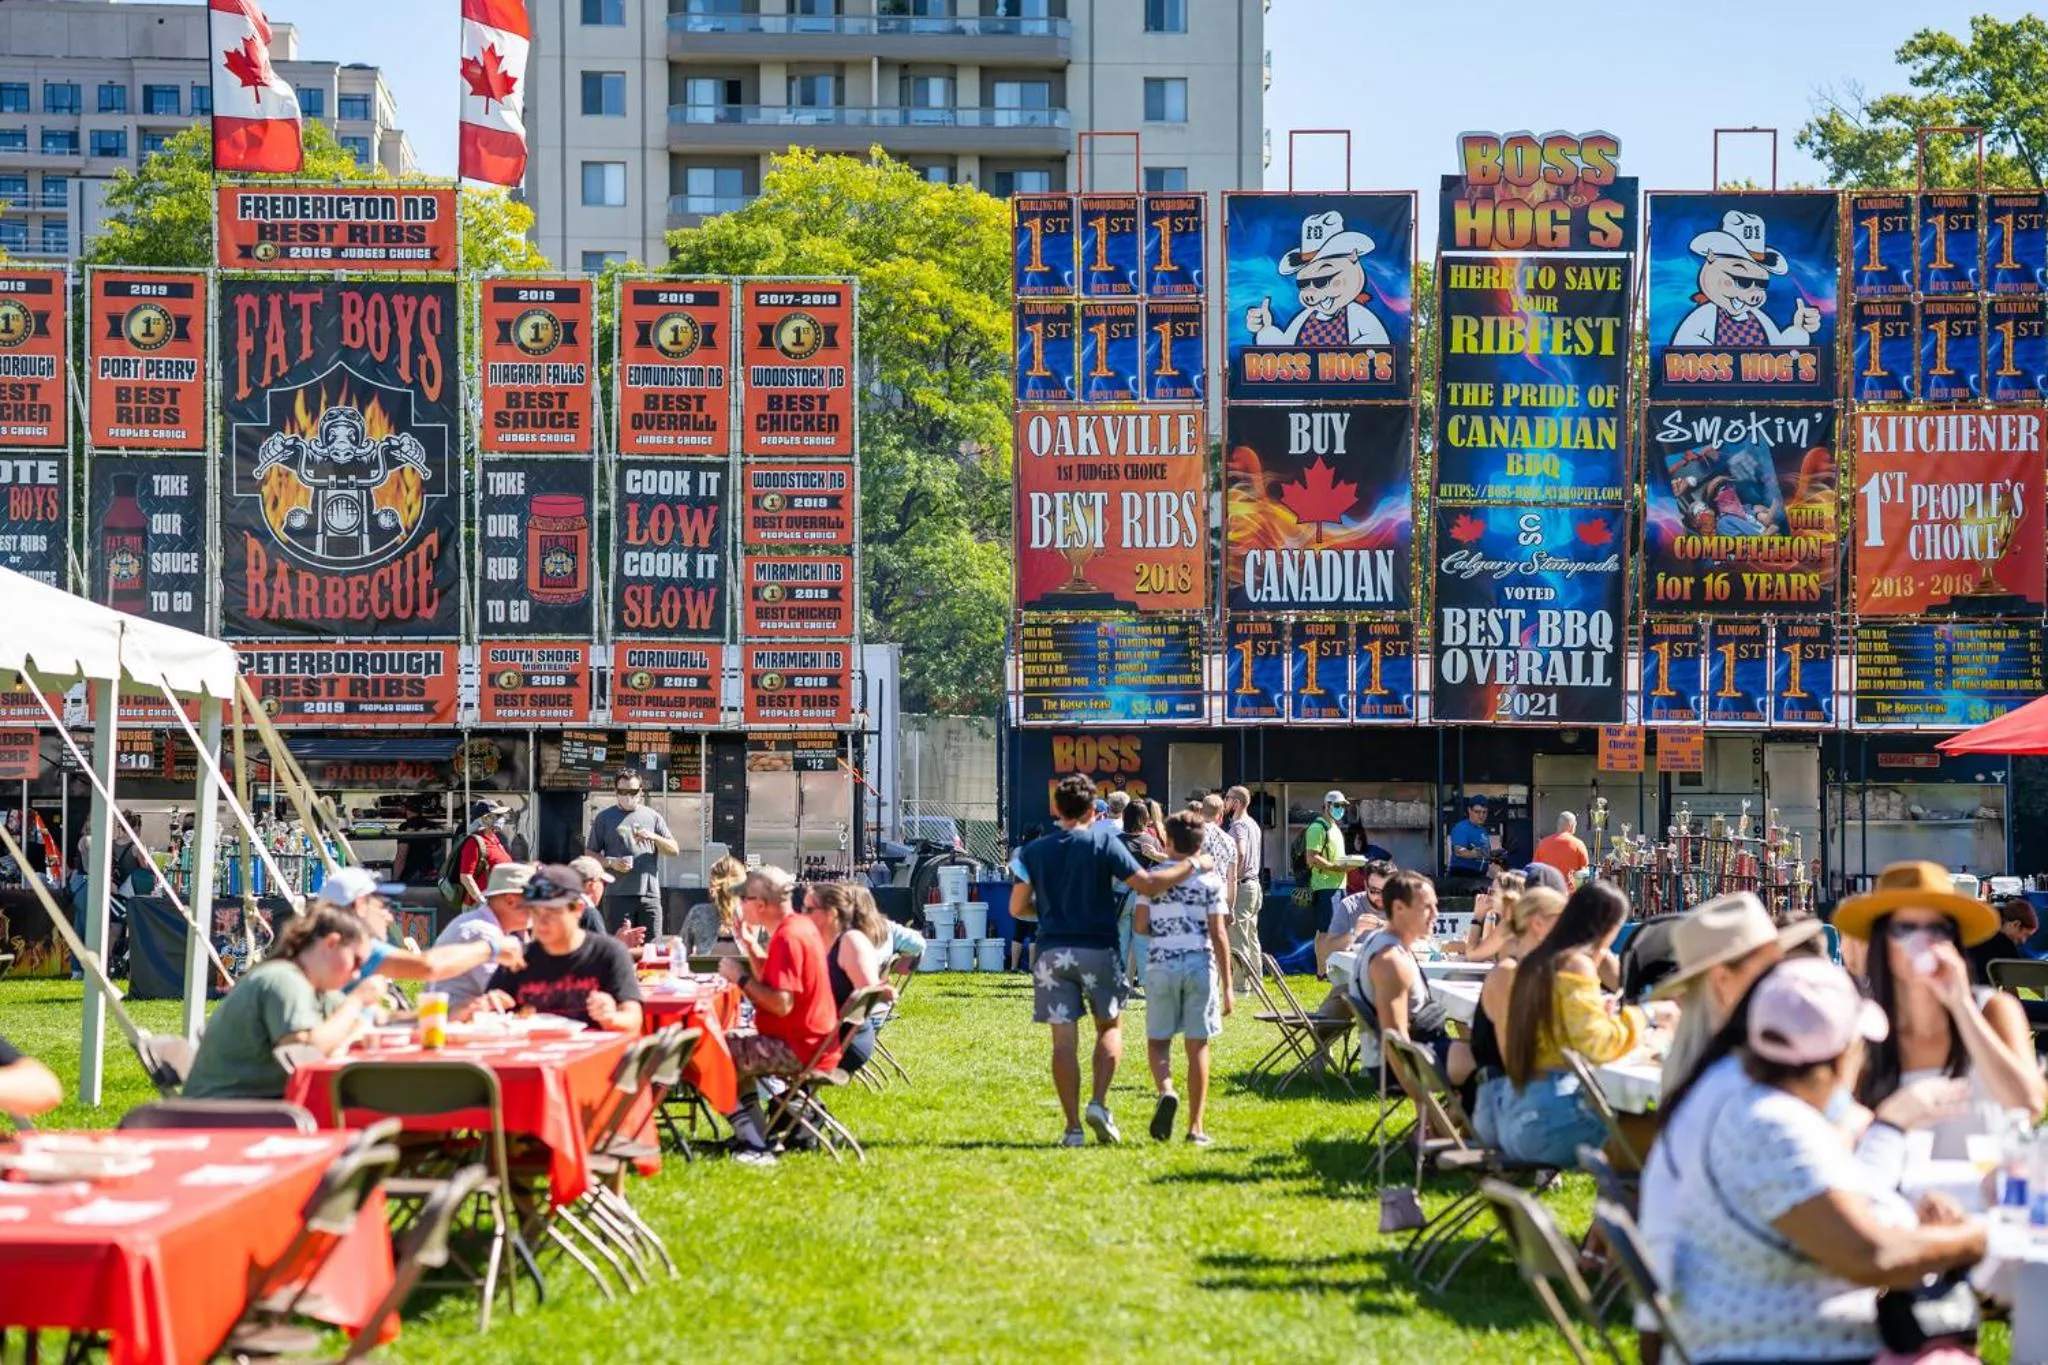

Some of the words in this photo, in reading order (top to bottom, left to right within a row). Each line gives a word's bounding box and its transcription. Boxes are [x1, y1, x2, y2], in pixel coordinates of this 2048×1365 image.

[1460, 133, 1620, 187] BOSS
[237, 194, 398, 222] FREDERICTON
[402, 195, 438, 222] NB
[257, 223, 338, 243] BEST
[348, 224, 426, 245] RIBS
[1023, 216, 1070, 272] 1ST
[1088, 216, 1135, 272] 1ST
[1152, 216, 1198, 272] 1ST
[1860, 215, 1908, 271] 1ST
[1927, 213, 1975, 269] 1ST
[1994, 213, 2043, 269] 1ST
[290, 247, 332, 259] 2019
[340, 247, 385, 259] JUDGES
[389, 248, 431, 259] CHOICE
[130, 284, 168, 296] 2019
[1450, 264, 1514, 289] HERE
[1525, 265, 1556, 290] TO
[1565, 266, 1622, 291] SAVE
[518, 290, 556, 301] 2019
[658, 293, 695, 304] 2019
[759, 294, 837, 305] 2017-2019
[1511, 296, 1559, 313] YOUR
[233, 288, 324, 400] FAT
[339, 291, 443, 402] BOYS
[1450, 315, 1621, 356] RIBFEST
[99, 356, 141, 380] PORT
[143, 357, 197, 381] PERRY
[489, 363, 543, 388] NIAGARA
[545, 364, 586, 386] FALLS
[627, 364, 705, 389] EDMUNDSTON
[707, 366, 724, 390] NB
[751, 365, 827, 389] WOODSTOCK
[828, 365, 845, 391] NB
[1245, 353, 1311, 381] BOSS
[1319, 350, 1392, 381] HOG'S
[1666, 353, 1734, 381] BOSS
[1741, 350, 1816, 381] HOG'S
[115, 385, 181, 404] BEST
[505, 391, 569, 410] BEST
[644, 394, 707, 412] BEST
[767, 394, 829, 412] BEST
[1447, 382, 1494, 407] THE
[1502, 383, 1579, 408] PRIDE
[1587, 384, 1620, 408] OF
[115, 407, 181, 425] RIBS
[494, 411, 580, 430] SAUCE
[631, 414, 717, 432] OVERALL
[756, 413, 839, 433] CHICKEN
[109, 427, 150, 438] PEOPLES
[152, 429, 187, 439] CHOICE
[498, 433, 537, 443] JUDGES
[540, 434, 576, 443] CHOICE
[635, 435, 675, 445] JUDGES
[677, 436, 713, 446] CHOICE
[1028, 414, 1197, 456] OAKVILLE
[1289, 413, 1350, 454] BUY
[1447, 414, 1618, 450] CANADIAN
[1861, 414, 2040, 453] KITCHENER
[1076, 464, 1120, 482] JUDGES
[1124, 463, 1167, 480] CHOICE
[1506, 452, 1560, 479] BBQ
[152, 474, 188, 497] TAKE
[487, 472, 525, 497] TAKE
[626, 469, 691, 496] COOK
[699, 471, 721, 497] IT
[752, 471, 826, 489] WOODSTOCK
[828, 471, 845, 491] NB
[9, 486, 59, 521] BOYS
[794, 497, 828, 508] 2019
[1860, 471, 1907, 547] 1ST
[1911, 478, 2025, 521] PEOPLE'S
[152, 513, 182, 536] OUR
[487, 514, 519, 539] OUR
[625, 502, 719, 548] LOW
[753, 515, 783, 529] BEST
[786, 516, 844, 529] OVERALL
[1029, 492, 1108, 549] BEST
[1121, 491, 1197, 549] RIBS
[1790, 508, 1825, 530] THE
[20, 535, 47, 553] RIBS
[1673, 535, 1823, 562] COMPETITION
[1909, 523, 1999, 562] CHOICE
[152, 552, 199, 575] SAUCE
[243, 528, 441, 620] BARBECUE
[487, 557, 518, 581] RUB
[623, 551, 689, 578] COOK
[696, 554, 719, 579] IT
[754, 562, 825, 582] MIRAMICHI
[826, 562, 843, 582] NB
[1245, 549, 1394, 603] CANADIAN
[1441, 549, 1518, 580] Calgary
[1518, 551, 1620, 579] Stampede
[1135, 563, 1192, 594] 2018
[1656, 572, 1695, 601] for
[1703, 572, 1731, 601] 16
[1742, 572, 1821, 601] YEARS
[1871, 575, 1915, 597] 2013
[1930, 573, 1974, 596] 2018
[151, 591, 169, 612] TO
[173, 592, 192, 612] GO
[1504, 587, 1555, 600] VOTED
[487, 600, 505, 623] TO
[510, 600, 530, 623] GO
[623, 584, 717, 630] SLOW
[755, 607, 786, 620] BEST
[788, 607, 842, 621] CHICKEN
[1442, 608, 1525, 647] BEST
[1537, 609, 1614, 654] BBQ
[238, 650, 444, 677] PETERBOROUGH
[490, 648, 533, 664] SOUTH
[537, 649, 581, 664] SHORE
[627, 649, 709, 670] CORNWALL
[753, 651, 822, 669] MIRAMICHI
[824, 651, 843, 669] NB
[1234, 639, 1280, 695] 1ST
[1298, 639, 1345, 695] 1ST
[1363, 639, 1409, 695] 1ST
[1441, 648, 1612, 687] OVERALL
[532, 676, 566, 686] 2019
[1650, 641, 1697, 697] 1ST
[1716, 642, 1764, 697] 1ST
[1781, 642, 1829, 698] 1ST
[261, 678, 340, 698] BEST
[350, 678, 426, 699] RIBS
[664, 677, 697, 687] 2019
[303, 702, 345, 713] 2019
[494, 694, 527, 707] BEST
[529, 694, 572, 708] SAUCE
[617, 695, 643, 706] BEST
[645, 696, 686, 708] PULLED
[689, 697, 716, 709] PORK
[757, 694, 796, 707] BEST
[801, 695, 839, 708] RIBS
[1496, 692, 1558, 716] 2021
[120, 754, 150, 768] $10
[807, 759, 824, 769] $12
[1052, 734, 1142, 773] BOSS
